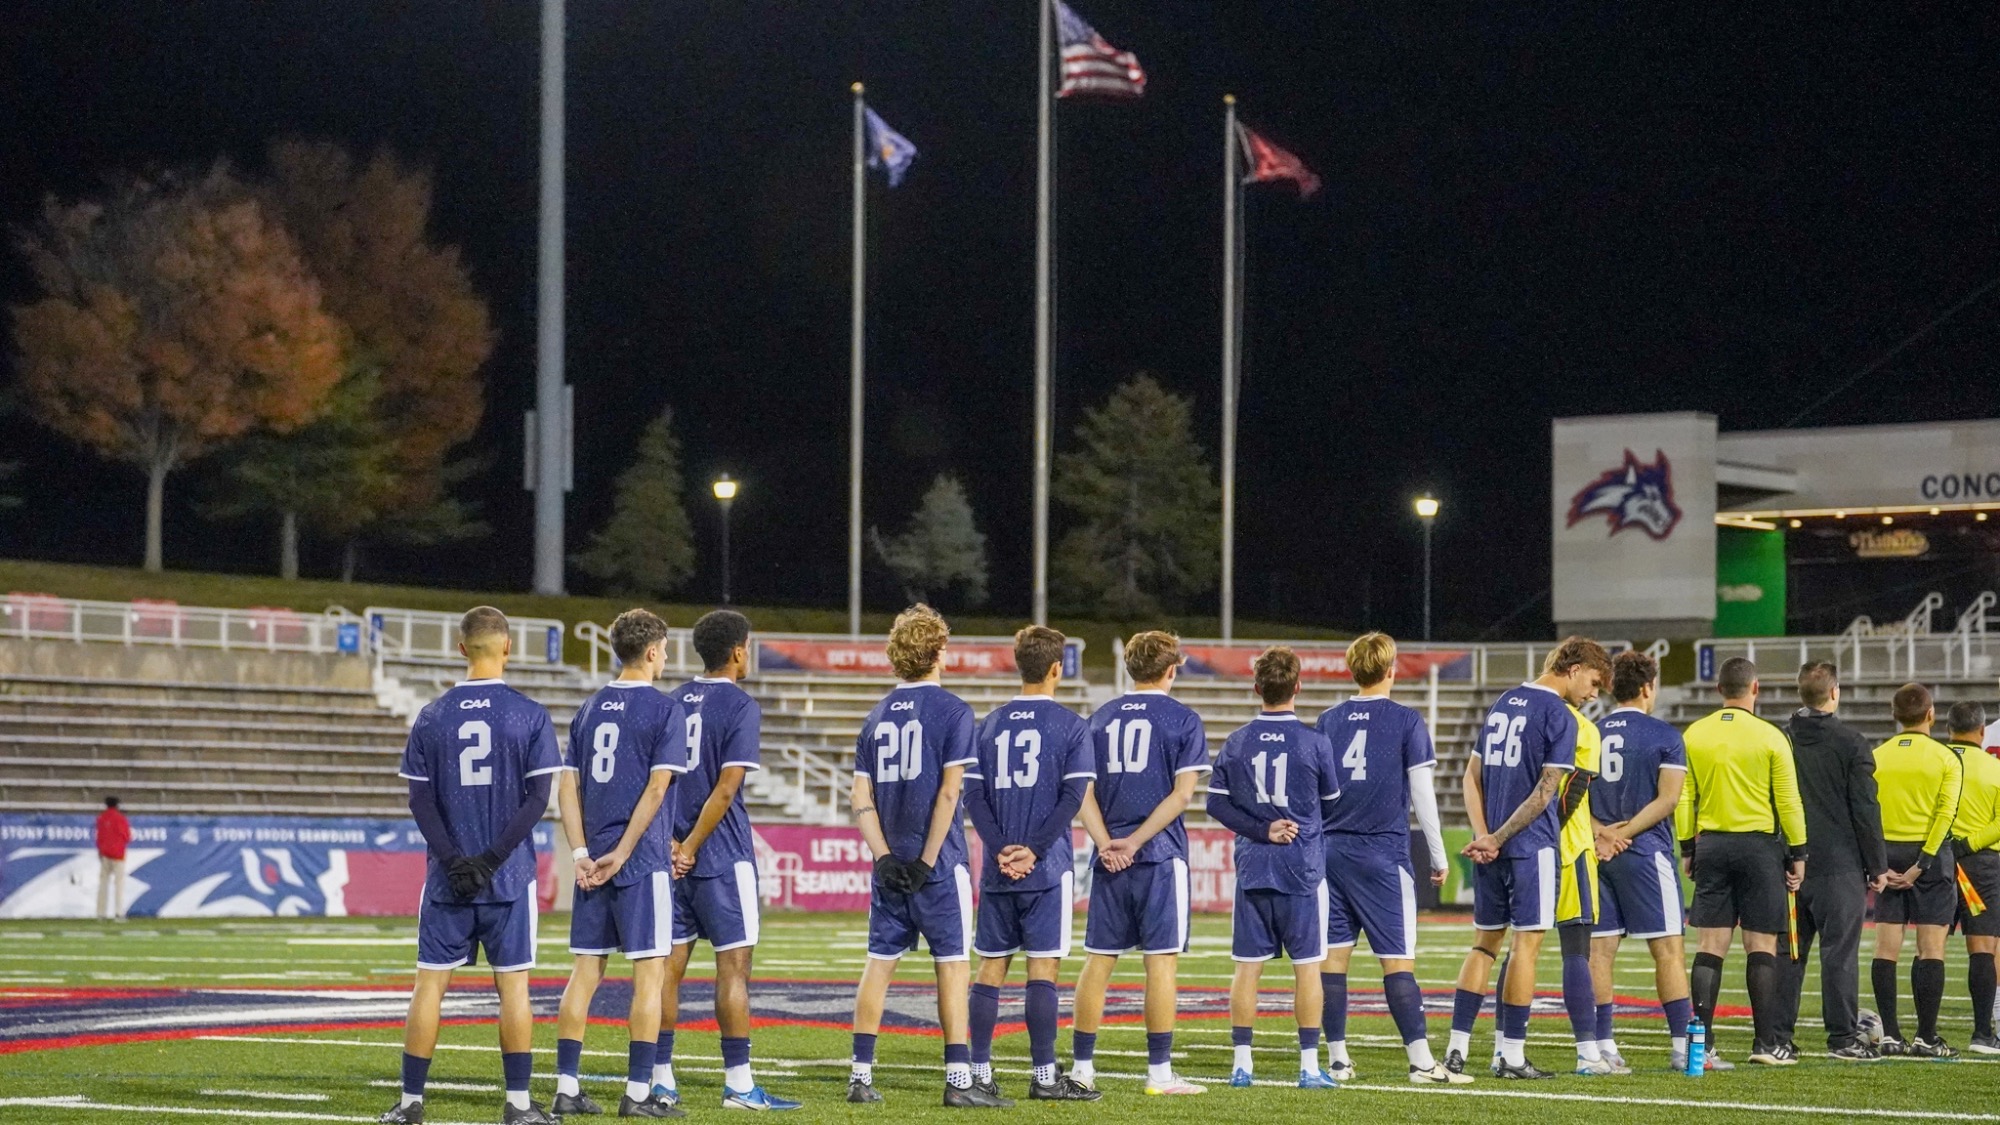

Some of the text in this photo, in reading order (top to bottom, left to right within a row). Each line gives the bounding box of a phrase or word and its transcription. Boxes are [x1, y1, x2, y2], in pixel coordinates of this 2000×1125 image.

[1921, 473, 2000, 499] CONC
[460, 698, 491, 709] CAA
[601, 701, 625, 711] CAA
[683, 693, 704, 702] CAA
[890, 701, 915, 711] CAA
[1121, 703, 1147, 711] CAA
[1508, 696, 1528, 707] CAA
[1009, 711, 1035, 720] CAA
[1347, 712, 1370, 721] CAA
[1604, 720, 1627, 728] CAA
[685, 712, 703, 771] 9
[1105, 718, 1153, 773] 10
[1259, 732, 1286, 742] CAA
[1484, 711, 1527, 768] 26
[458, 720, 493, 787] 2
[591, 722, 620, 783] 8
[874, 719, 923, 783] 20
[994, 729, 1042, 789] 13
[1342, 729, 1367, 780] 4
[1601, 734, 1625, 782] 6
[1251, 751, 1289, 807] 11
[1, 826, 44, 841] STONY
[47, 826, 91, 841] BROOK
[213, 828, 366, 843] STONY BROOK SEAWOLVES
[794, 871, 872, 894] SEAWOL
